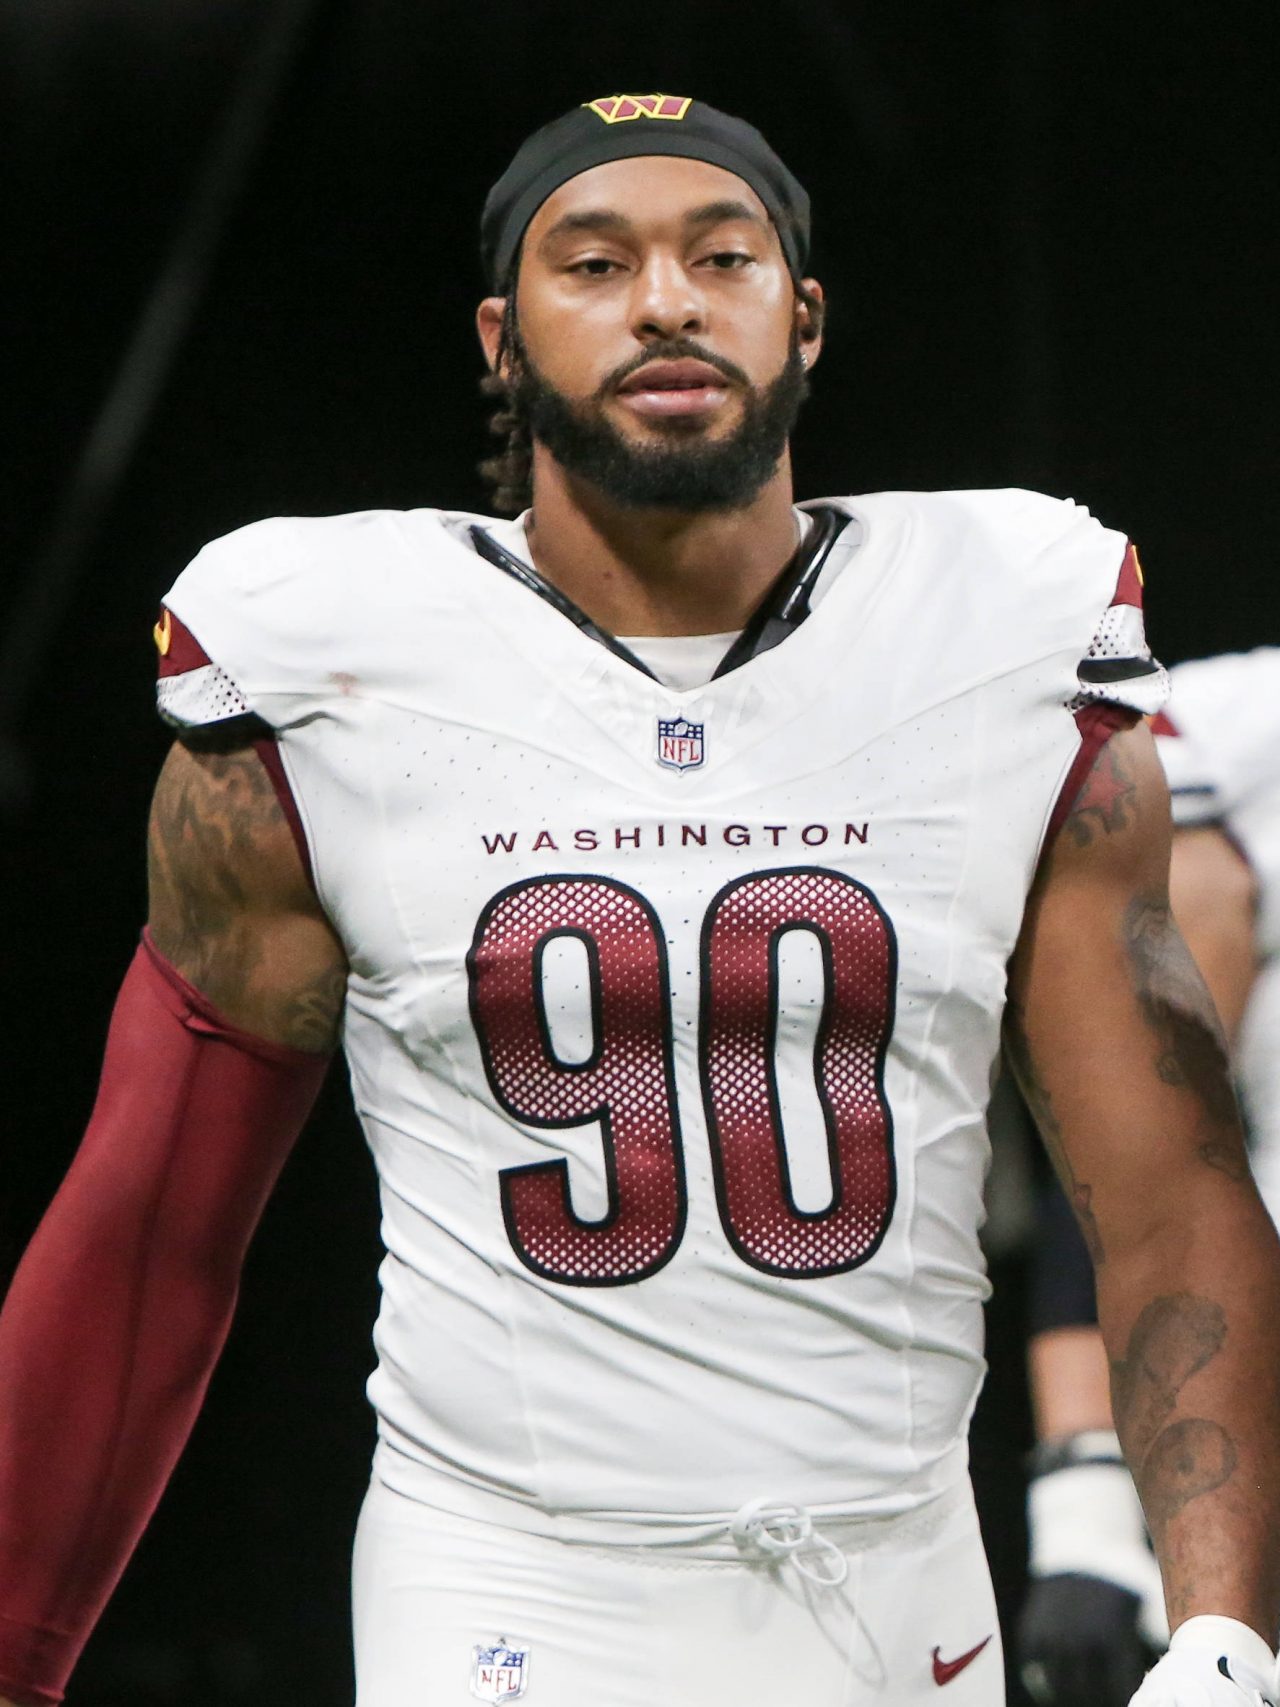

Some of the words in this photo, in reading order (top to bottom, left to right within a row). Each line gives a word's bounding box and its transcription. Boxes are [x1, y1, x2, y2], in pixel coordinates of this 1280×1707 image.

[663, 737, 699, 763] NFL
[481, 822, 870, 855] WASHINGTON
[466, 866, 898, 1287] 90
[481, 1668, 517, 1693] NFL
